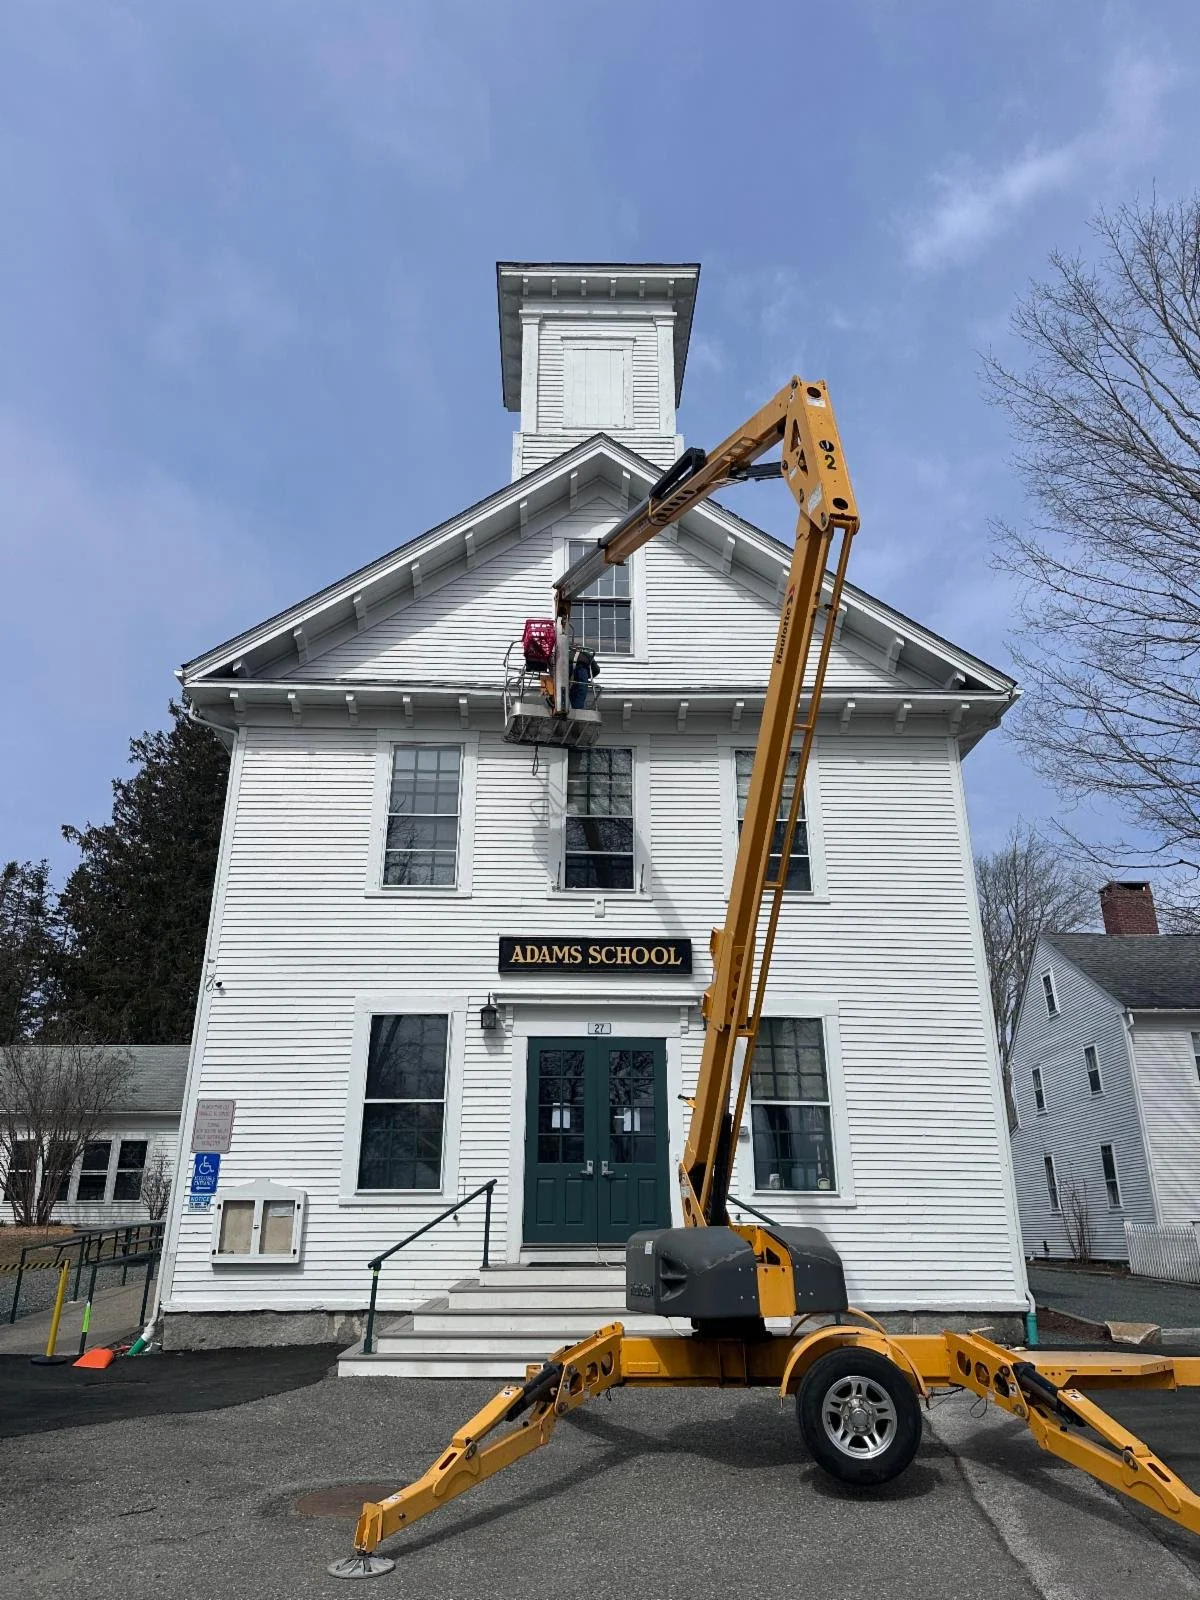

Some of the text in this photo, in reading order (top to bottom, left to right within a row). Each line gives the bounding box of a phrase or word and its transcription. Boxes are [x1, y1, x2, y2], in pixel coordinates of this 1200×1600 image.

[824, 454, 837, 471] 2
[775, 607, 793, 665] Haulotte
[509, 944, 683, 966] ADAMS SCHOOL
[594, 1023, 605, 1034] 27
